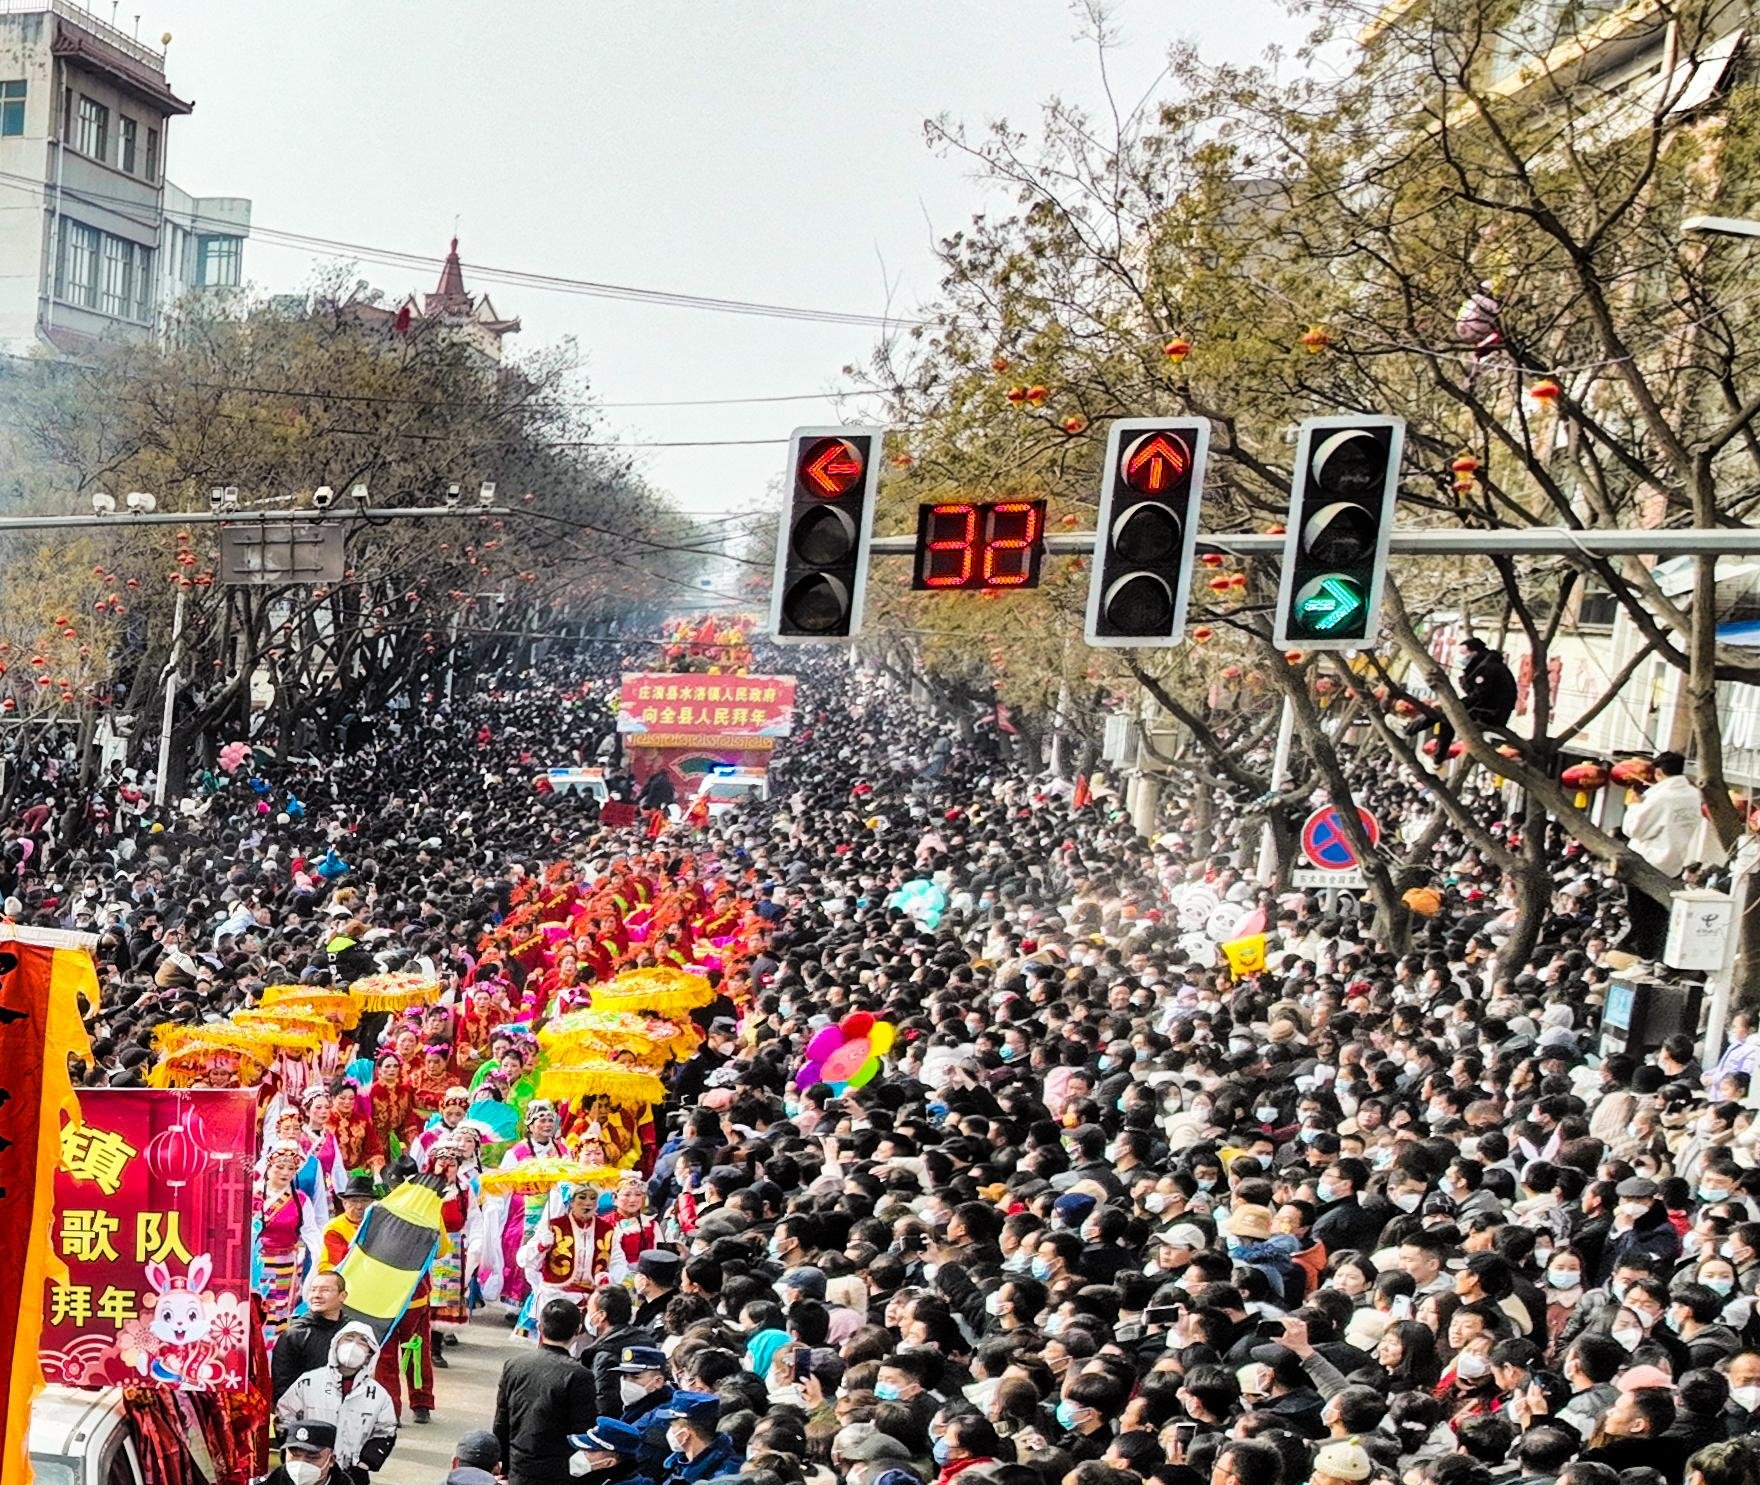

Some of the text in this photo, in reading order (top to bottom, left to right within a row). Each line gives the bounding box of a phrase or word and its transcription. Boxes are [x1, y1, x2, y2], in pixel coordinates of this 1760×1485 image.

[924, 503, 1038, 587] 32
[638, 685, 777, 703] 庄浪县水洛镇人民政府
[642, 706, 768, 727] 向全县人民拜年
[60, 1119, 137, 1196] 镇
[59, 1209, 193, 1264] 歌队
[50, 1284, 138, 1329] 拜年
